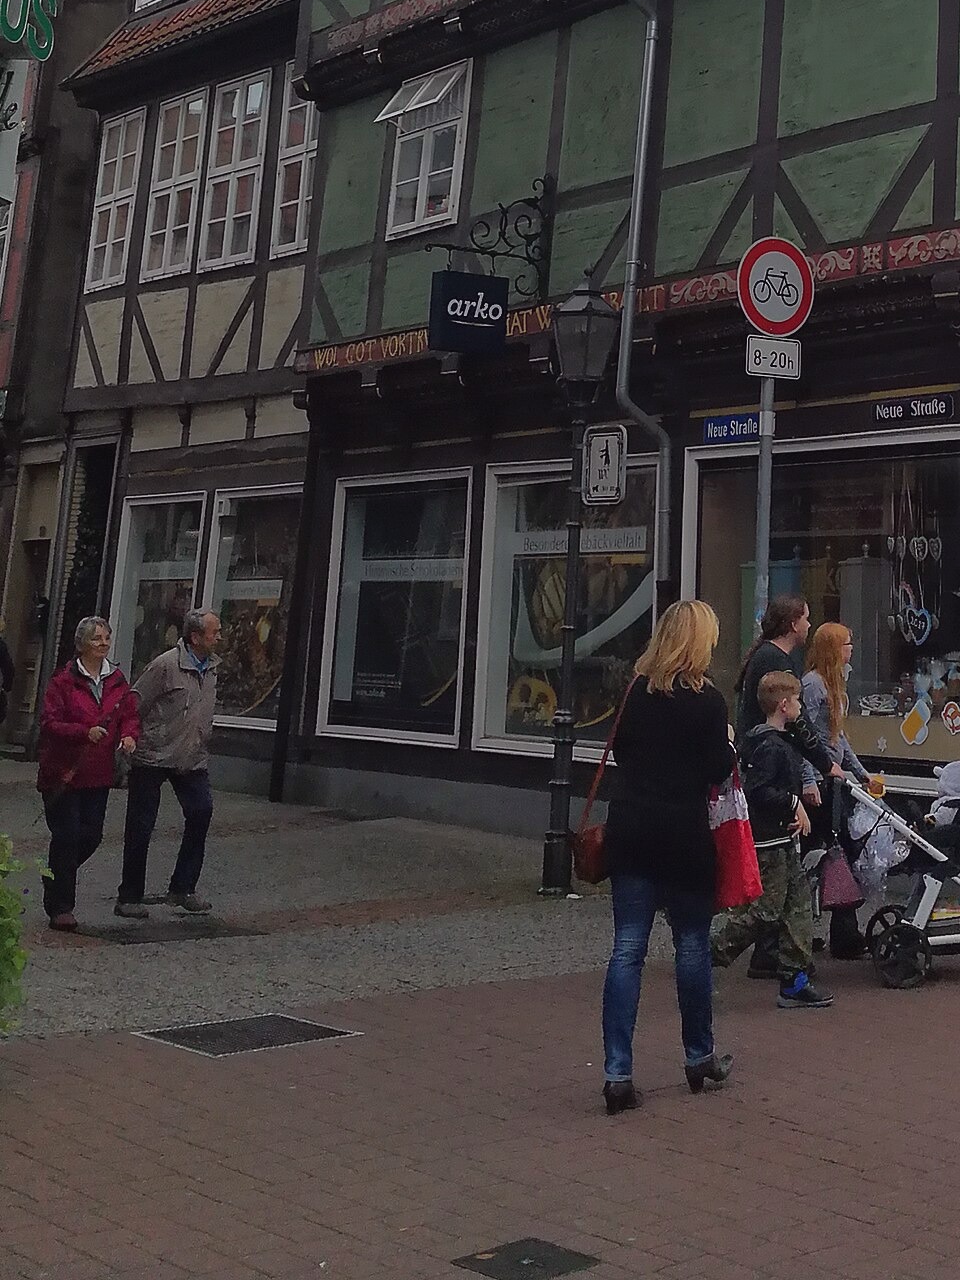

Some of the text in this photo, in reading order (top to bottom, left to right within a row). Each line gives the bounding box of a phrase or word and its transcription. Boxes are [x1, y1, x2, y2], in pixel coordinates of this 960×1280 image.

[447, 292, 503, 320] arko
[345, 339, 377, 364] GOT
[505, 309, 533, 337] AT
[876, 398, 946, 420] Neue Straße
[707, 418, 758, 437] Neue Straße
